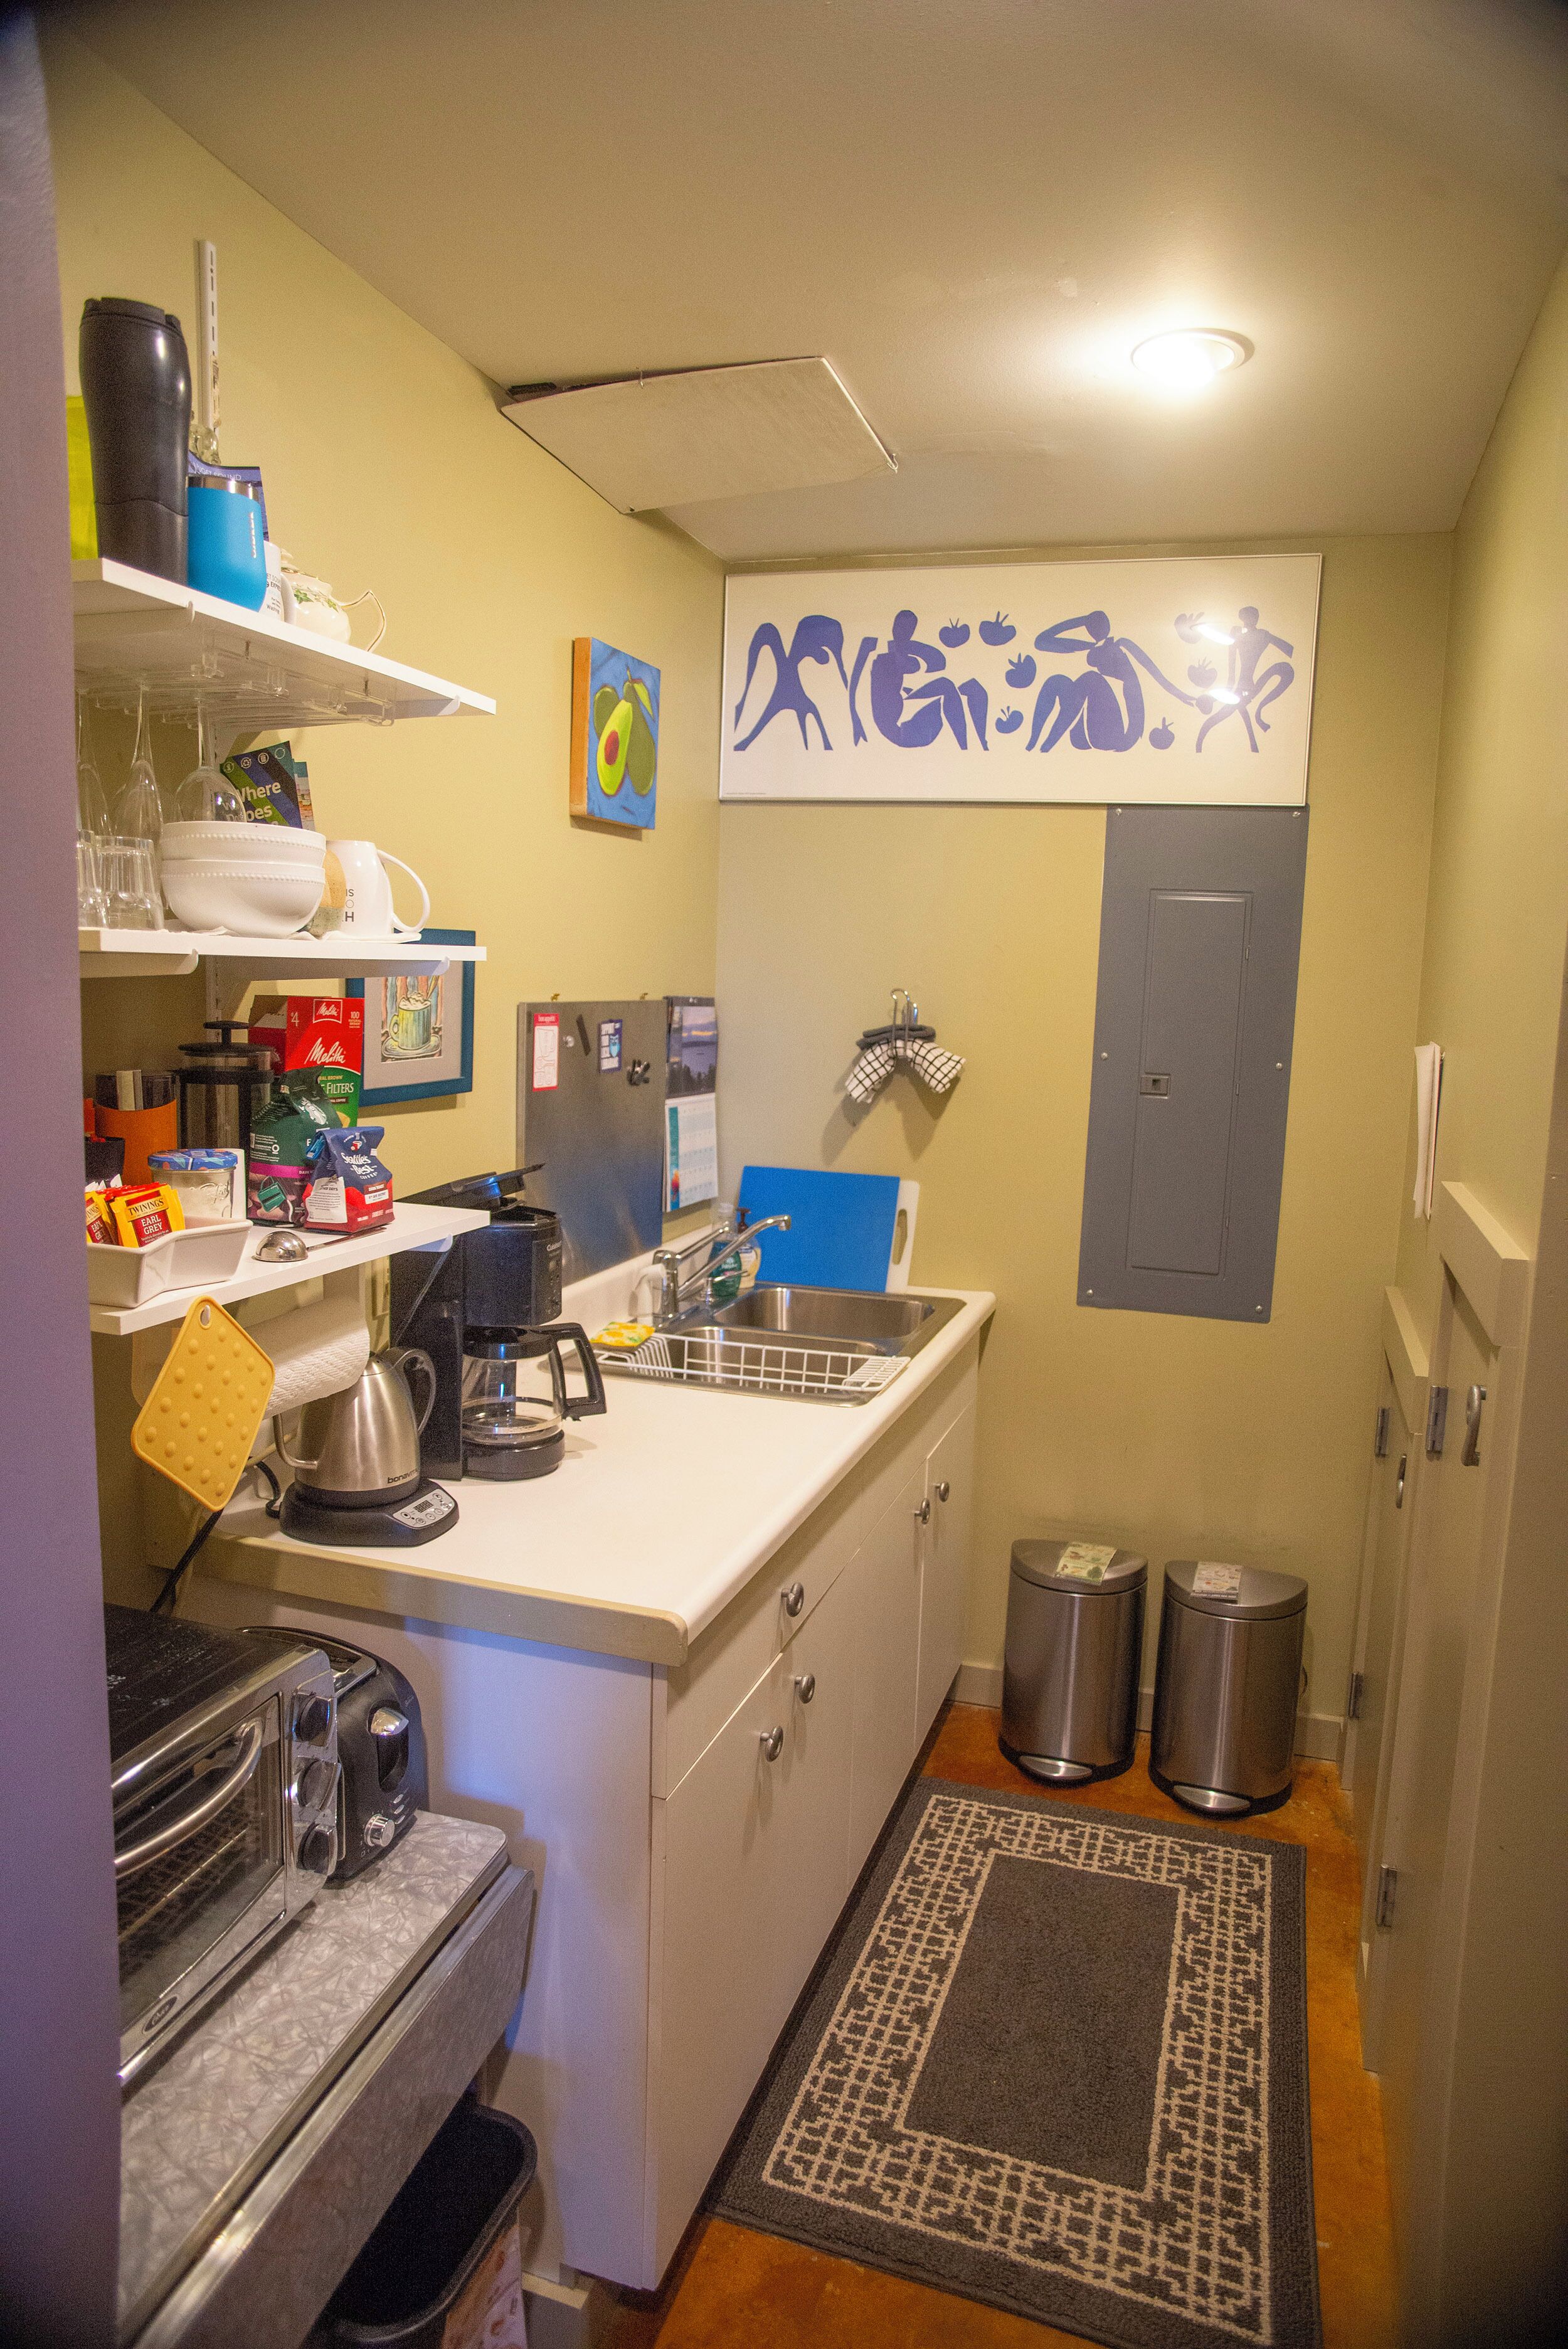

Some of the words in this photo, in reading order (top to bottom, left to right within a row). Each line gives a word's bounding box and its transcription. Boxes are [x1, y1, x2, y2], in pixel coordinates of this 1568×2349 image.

[246, 805, 272, 821] oes
[317, 1002, 338, 1016] Melitta
[351, 1011, 360, 1019] 100
[304, 1037, 346, 1064] Melitta
[341, 1152, 372, 1165] Seattle's
[127, 1197, 164, 1216] TWININGS
[140, 1214, 161, 1228] EARL
[143, 1222, 163, 1235] GREY
